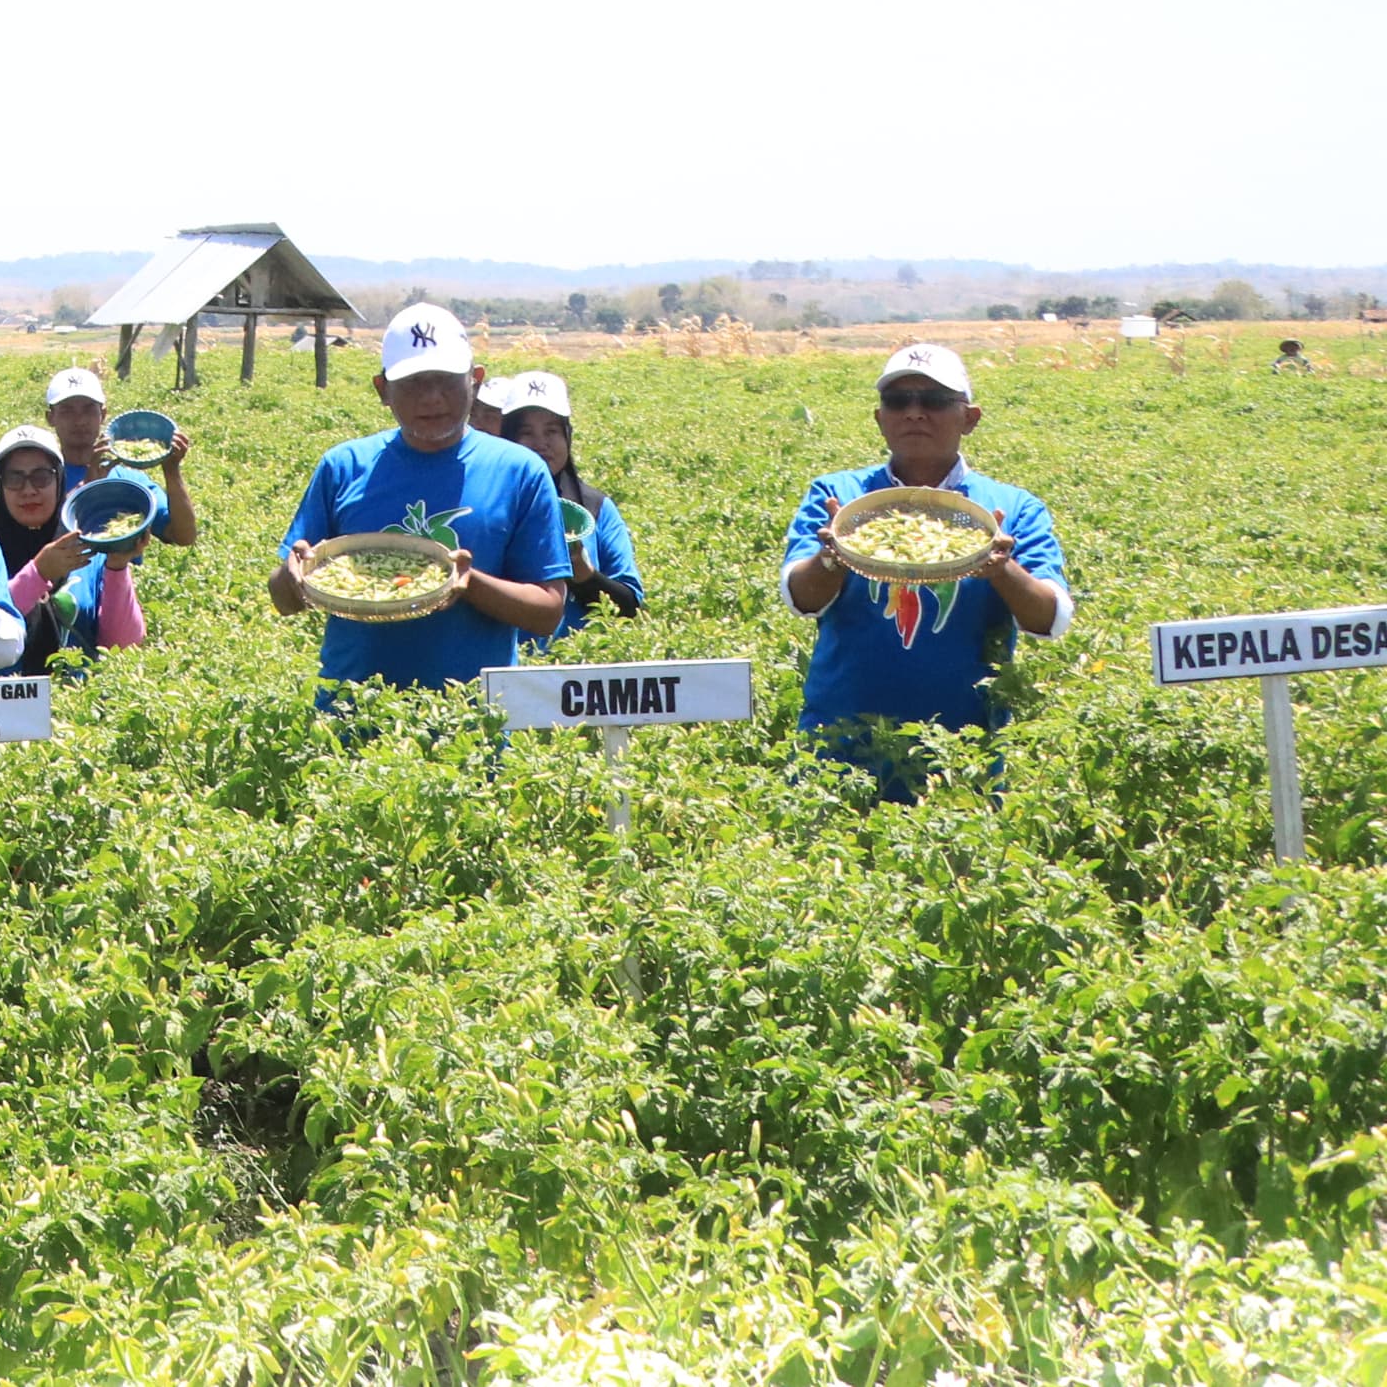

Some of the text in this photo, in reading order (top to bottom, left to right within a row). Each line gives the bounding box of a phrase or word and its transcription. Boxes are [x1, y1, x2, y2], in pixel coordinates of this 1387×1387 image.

[410, 322, 438, 348] NY
[1172, 628, 1302, 669] KEPALA
[561, 676, 681, 717] CAMAT
